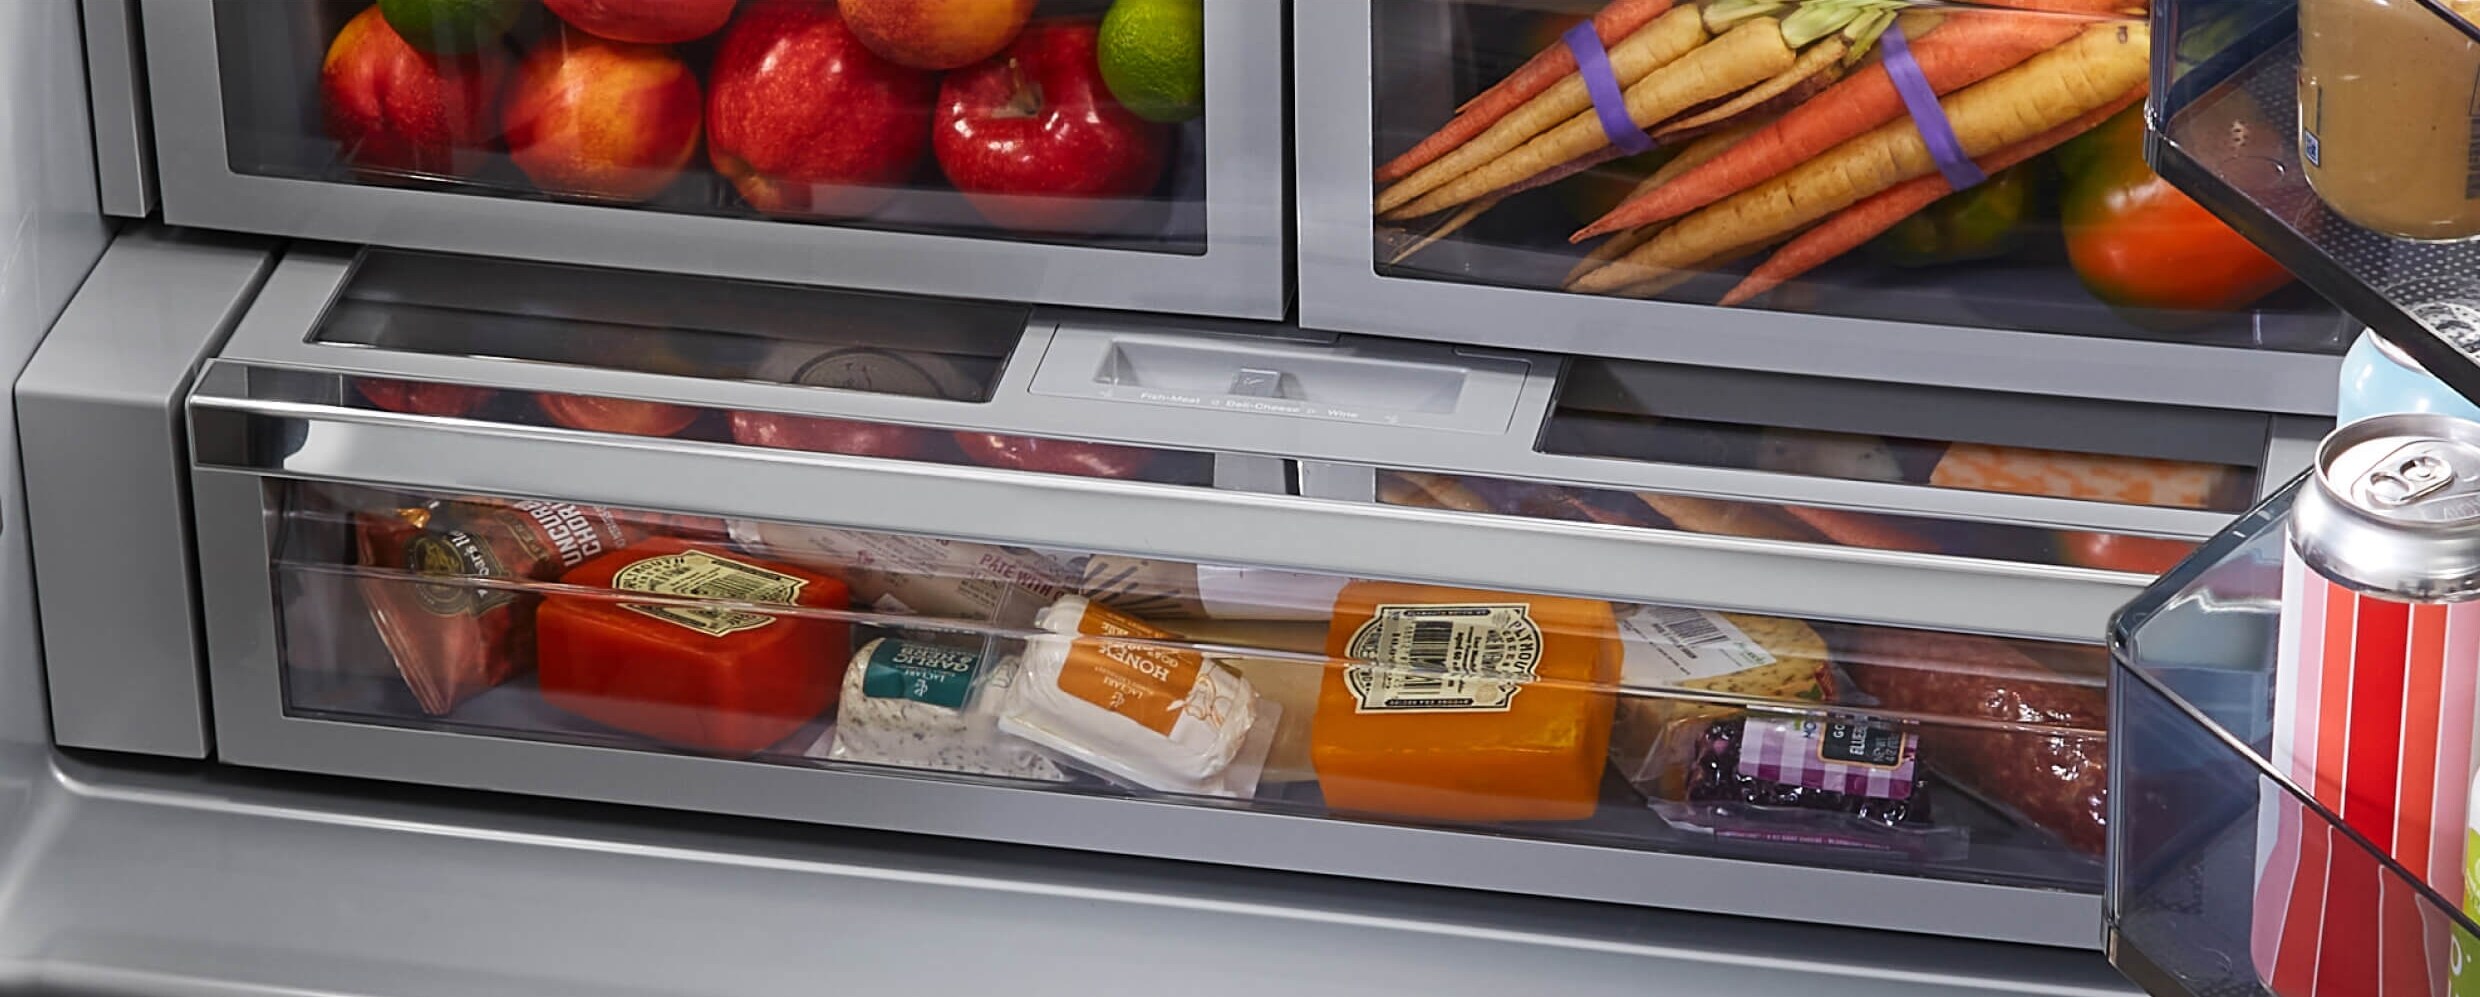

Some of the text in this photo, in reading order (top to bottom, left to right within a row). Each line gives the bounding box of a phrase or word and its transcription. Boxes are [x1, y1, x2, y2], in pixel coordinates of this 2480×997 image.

[1327, 409, 1360, 420] Wine
[545, 501, 603, 557] CHORI
[892, 654, 970, 672] GARLIC
[1098, 643, 1170, 682] HONEY
